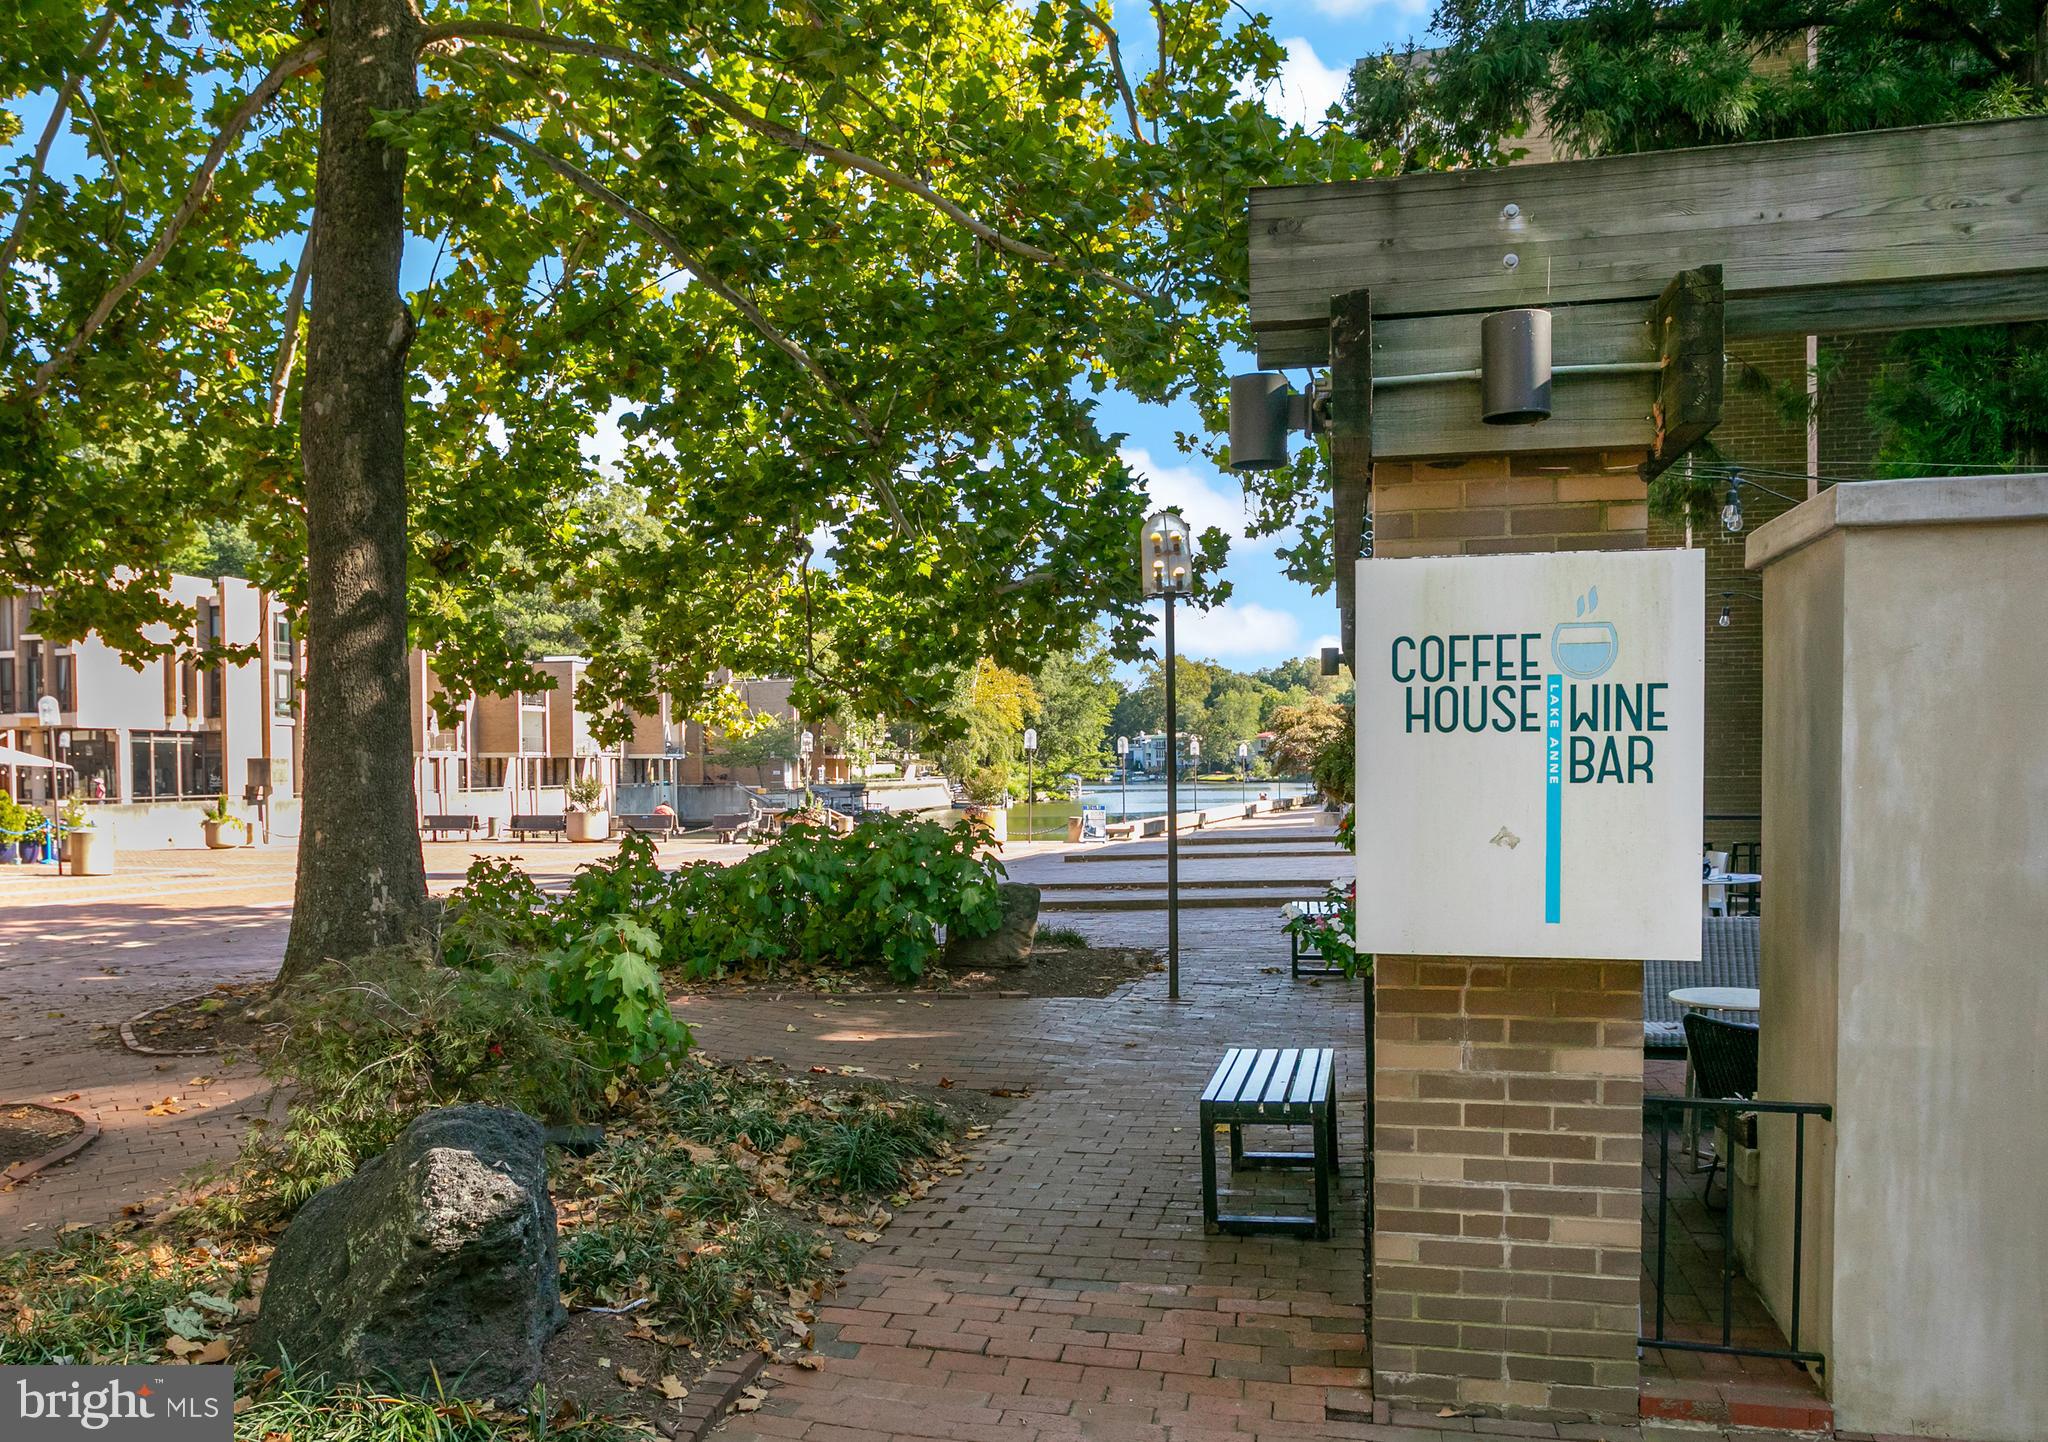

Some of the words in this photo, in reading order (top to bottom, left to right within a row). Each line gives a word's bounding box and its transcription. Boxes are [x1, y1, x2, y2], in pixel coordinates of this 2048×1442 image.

[1391, 633, 1541, 683] COFFEE
[1405, 684, 1541, 733] HOUSE
[1549, 684, 1560, 728] LAKE
[1570, 682, 1668, 732] WINE
[1549, 737, 1560, 784] ANNE
[1569, 735, 1654, 784] BAR
